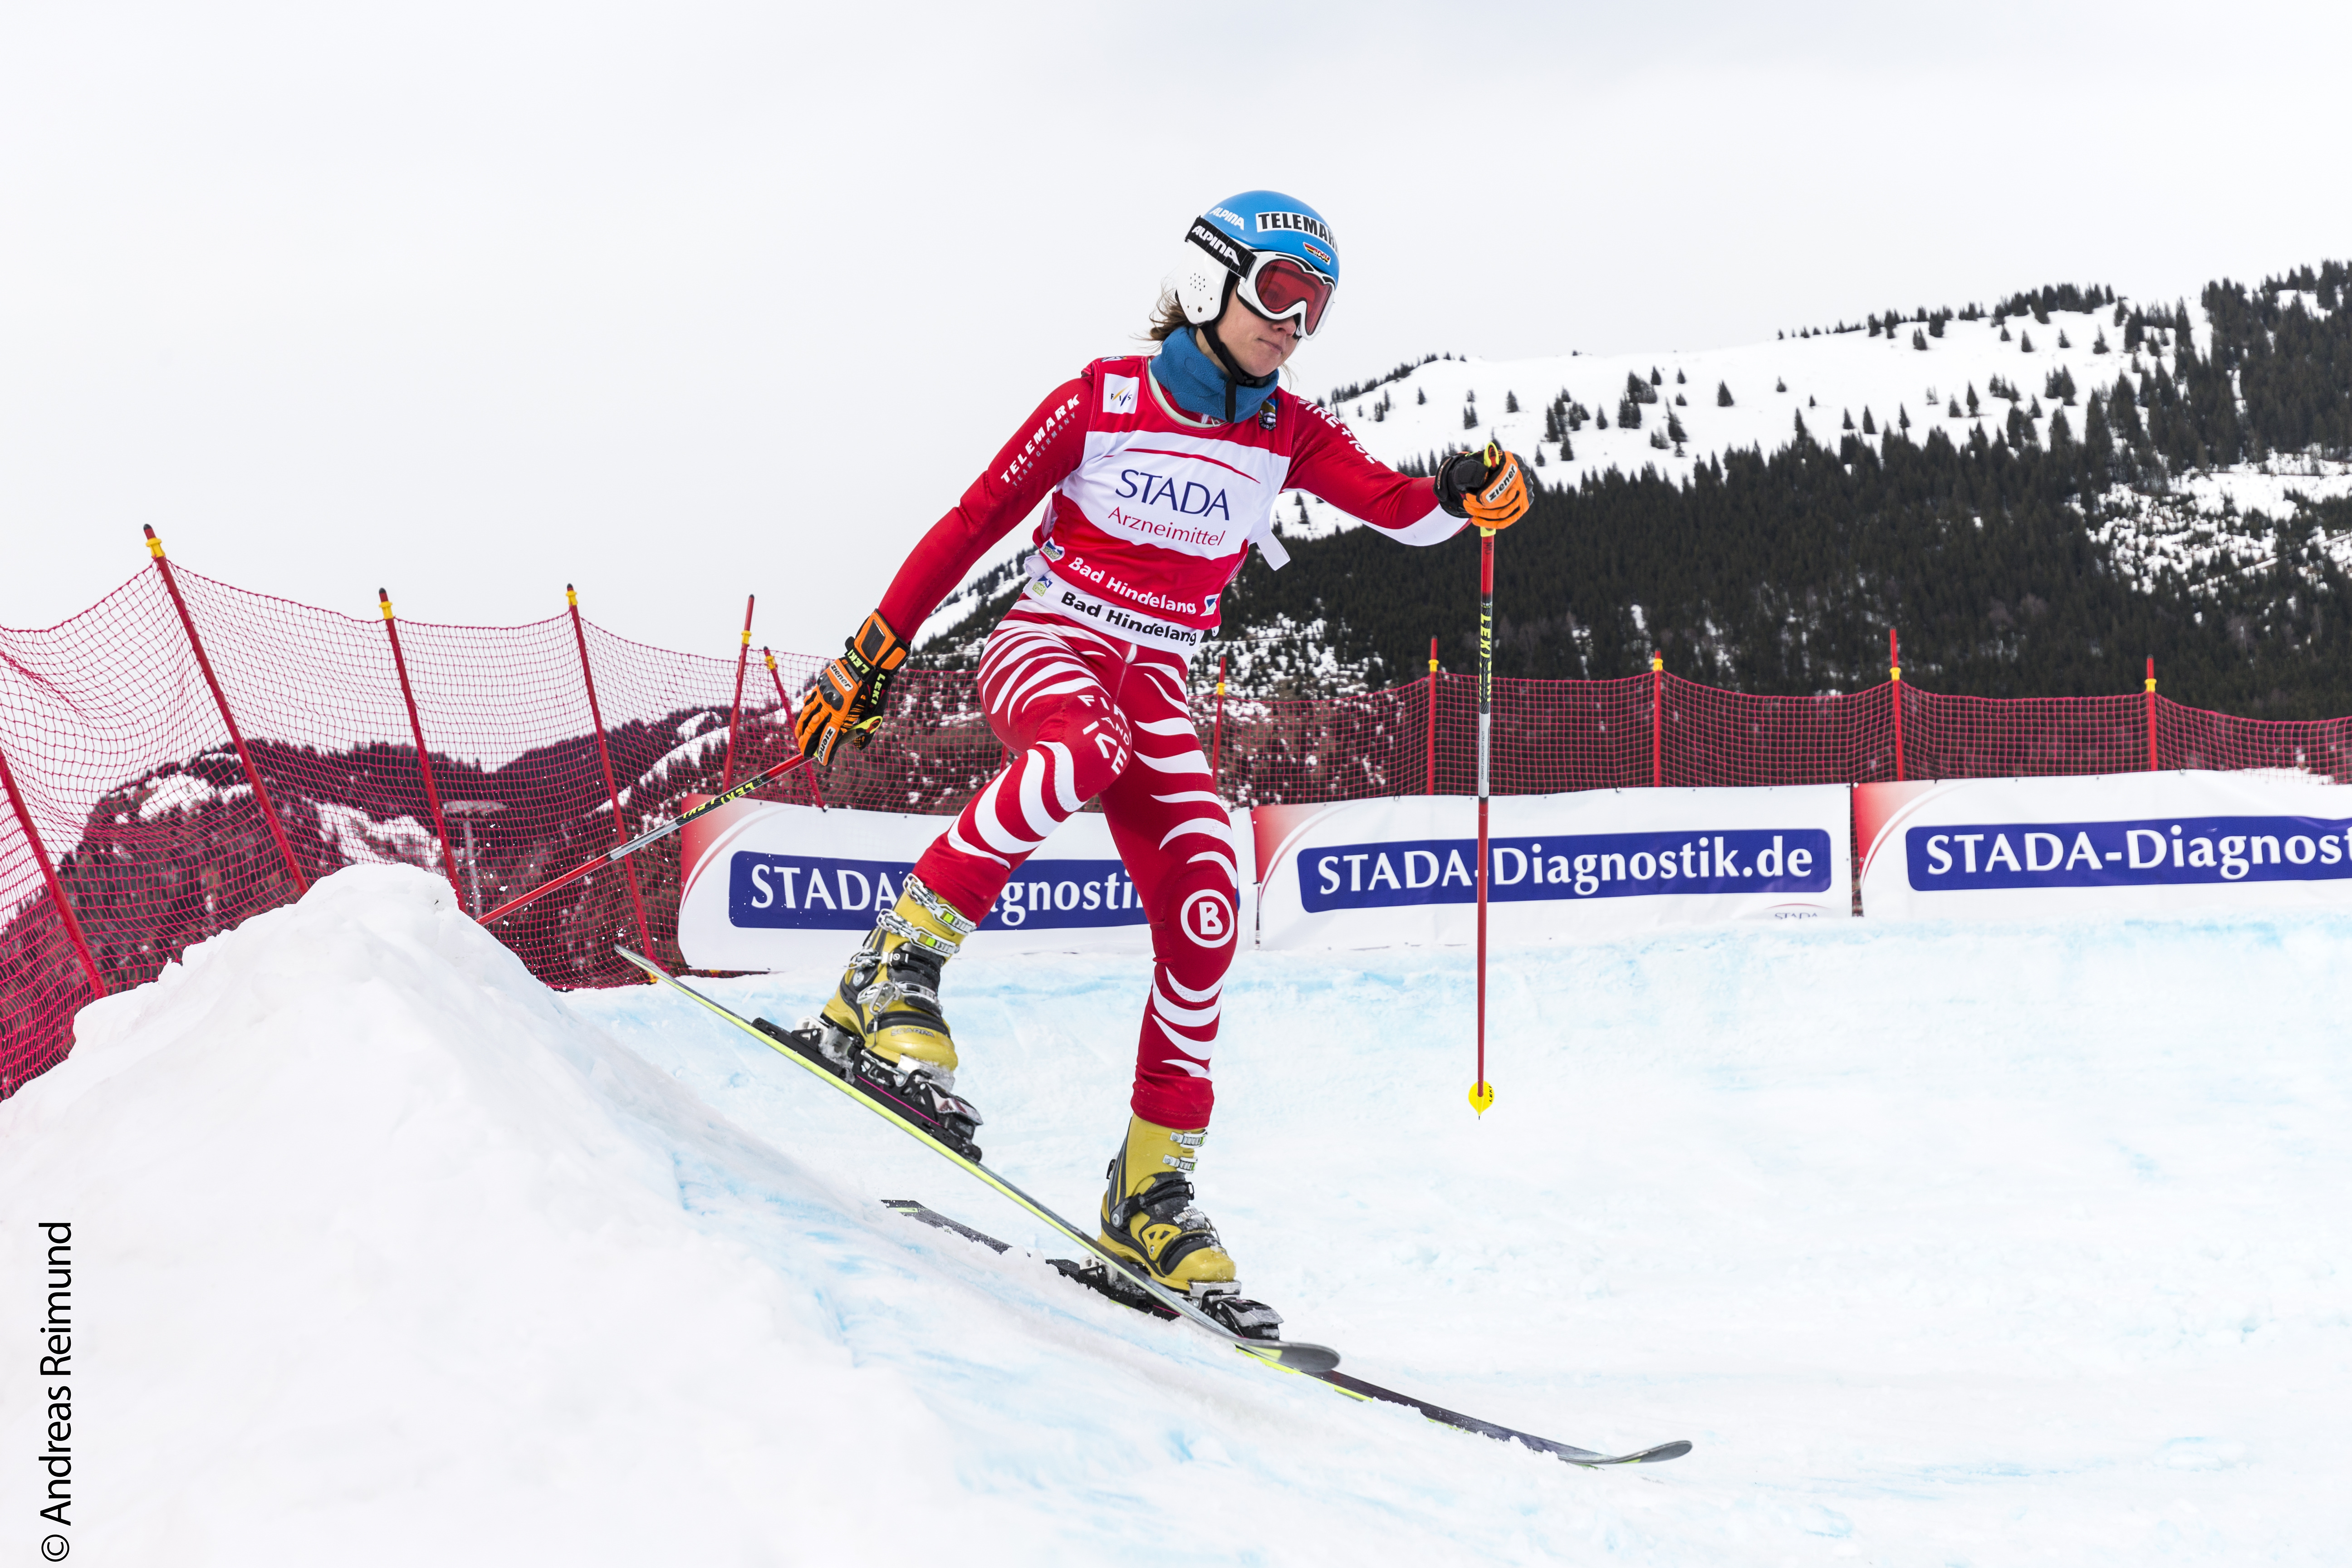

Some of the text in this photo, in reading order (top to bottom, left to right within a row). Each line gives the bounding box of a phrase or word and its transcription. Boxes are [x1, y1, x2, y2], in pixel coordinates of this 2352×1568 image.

[1209, 207, 1245, 230] ALPINA
[1191, 225, 1240, 266] ALPINA
[1000, 393, 1079, 483] TELEMARK
[1012, 412, 1075, 487] TEAM GERMANY
[1115, 469, 1230, 521] STADA
[1489, 465, 1517, 501] ziener
[1108, 506, 1226, 546] Arzneimittel
[1068, 557, 1196, 614] Bad Hindelang
[1061, 591, 1197, 646] Bad Hindelang
[1480, 613, 1491, 658] LEKI
[831, 665, 852, 690] ziener
[847, 649, 870, 674] LEKI
[871, 673, 886, 705] LEKI
[818, 728, 833, 762] ziener
[1082, 720, 1127, 775] ICE
[891, 1027, 935, 1038] SCARPA
